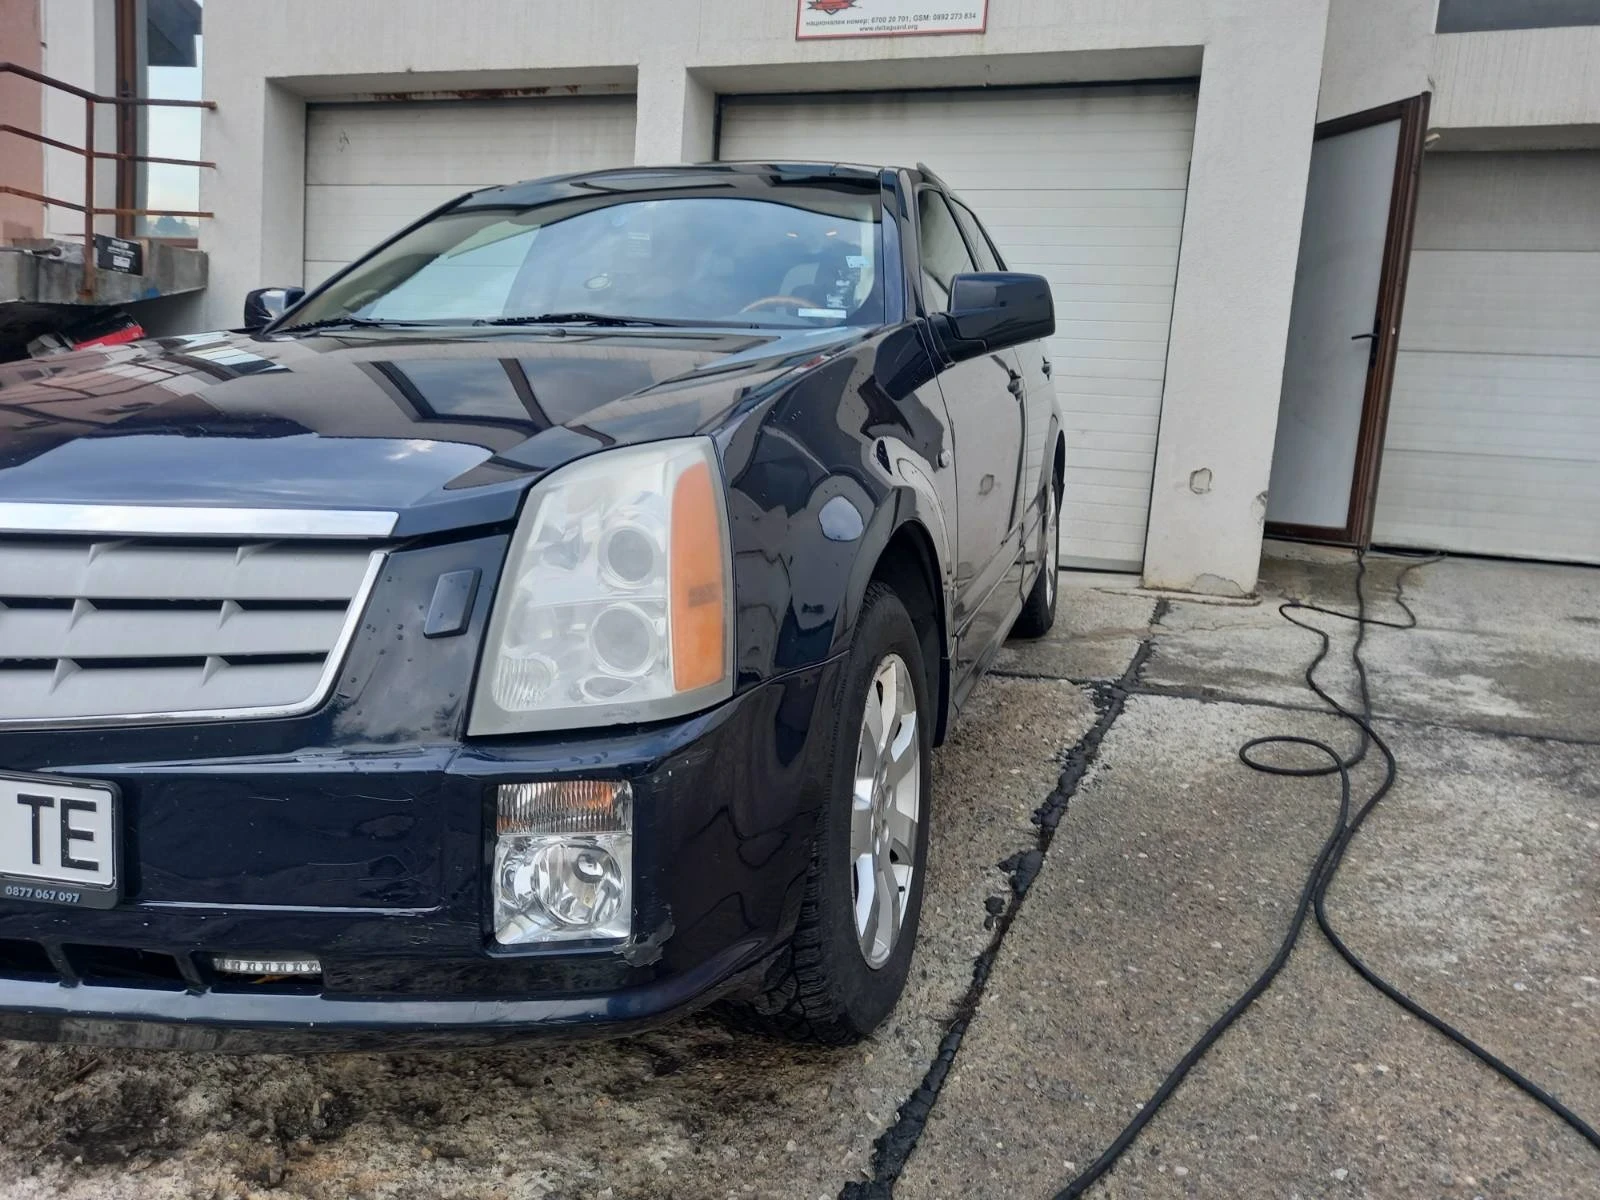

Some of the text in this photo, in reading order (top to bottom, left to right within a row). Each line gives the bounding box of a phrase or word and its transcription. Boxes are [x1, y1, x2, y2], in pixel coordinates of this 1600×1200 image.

[846, 17, 869, 26] номер:
[888, 15, 896, 23] 20
[897, 15, 911, 24] 701,
[913, 14, 931, 22] GSM:
[950, 12, 962, 20] 273
[17, 793, 99, 871] TE
[5, 885, 80, 903] 0877 067 097
